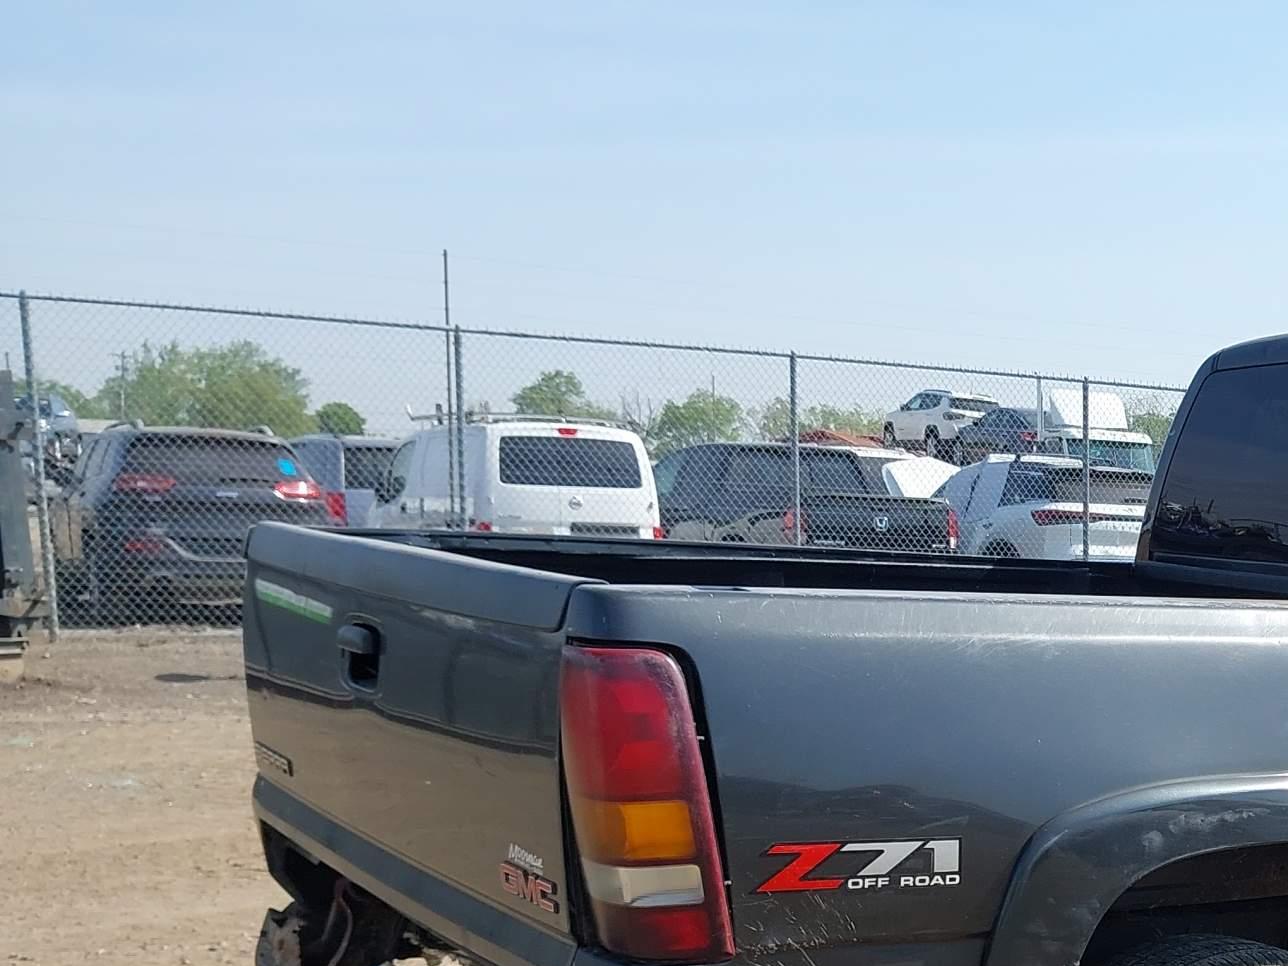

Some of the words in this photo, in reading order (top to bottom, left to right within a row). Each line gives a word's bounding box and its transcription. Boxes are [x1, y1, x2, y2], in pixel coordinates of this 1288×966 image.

[500, 861, 559, 914] GMC
[756, 839, 960, 893] Z71
[847, 876, 890, 890] OFF
[900, 874, 961, 888] ROAD
